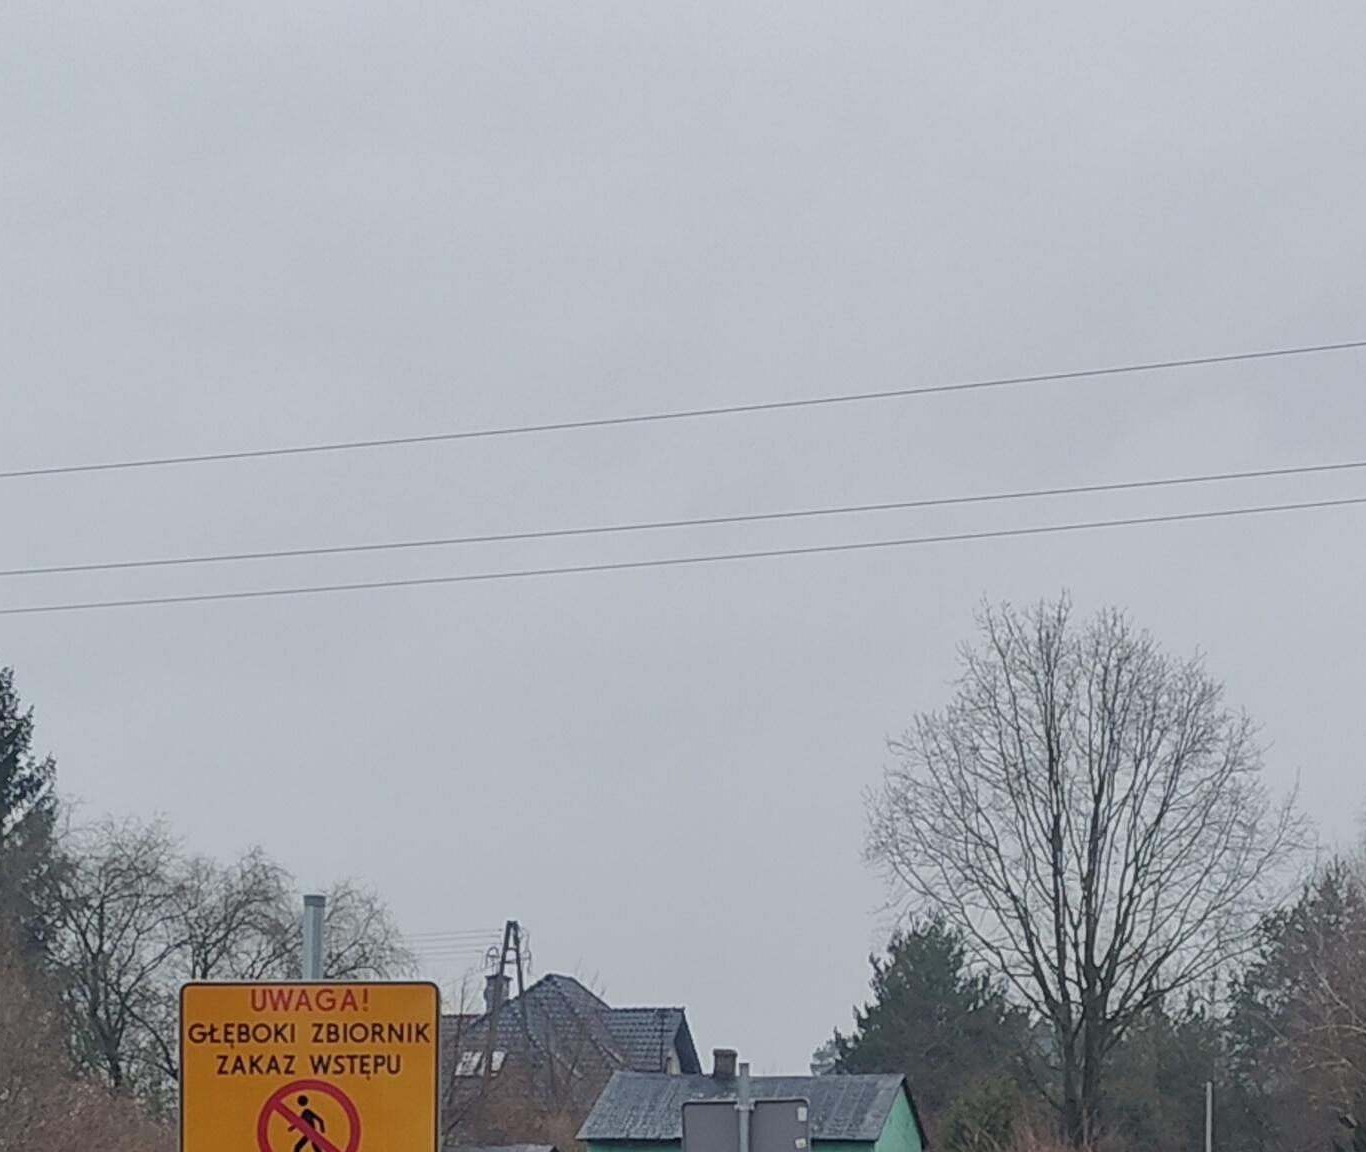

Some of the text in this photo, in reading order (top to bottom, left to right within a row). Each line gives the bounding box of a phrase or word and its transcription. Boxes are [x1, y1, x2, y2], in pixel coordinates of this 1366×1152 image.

[250, 988, 369, 1013] UWAGA!
[188, 1022, 430, 1049] GŁĘBOKI ZBIORNIK
[216, 1055, 401, 1081] ZAKAZ WSTĘPU
